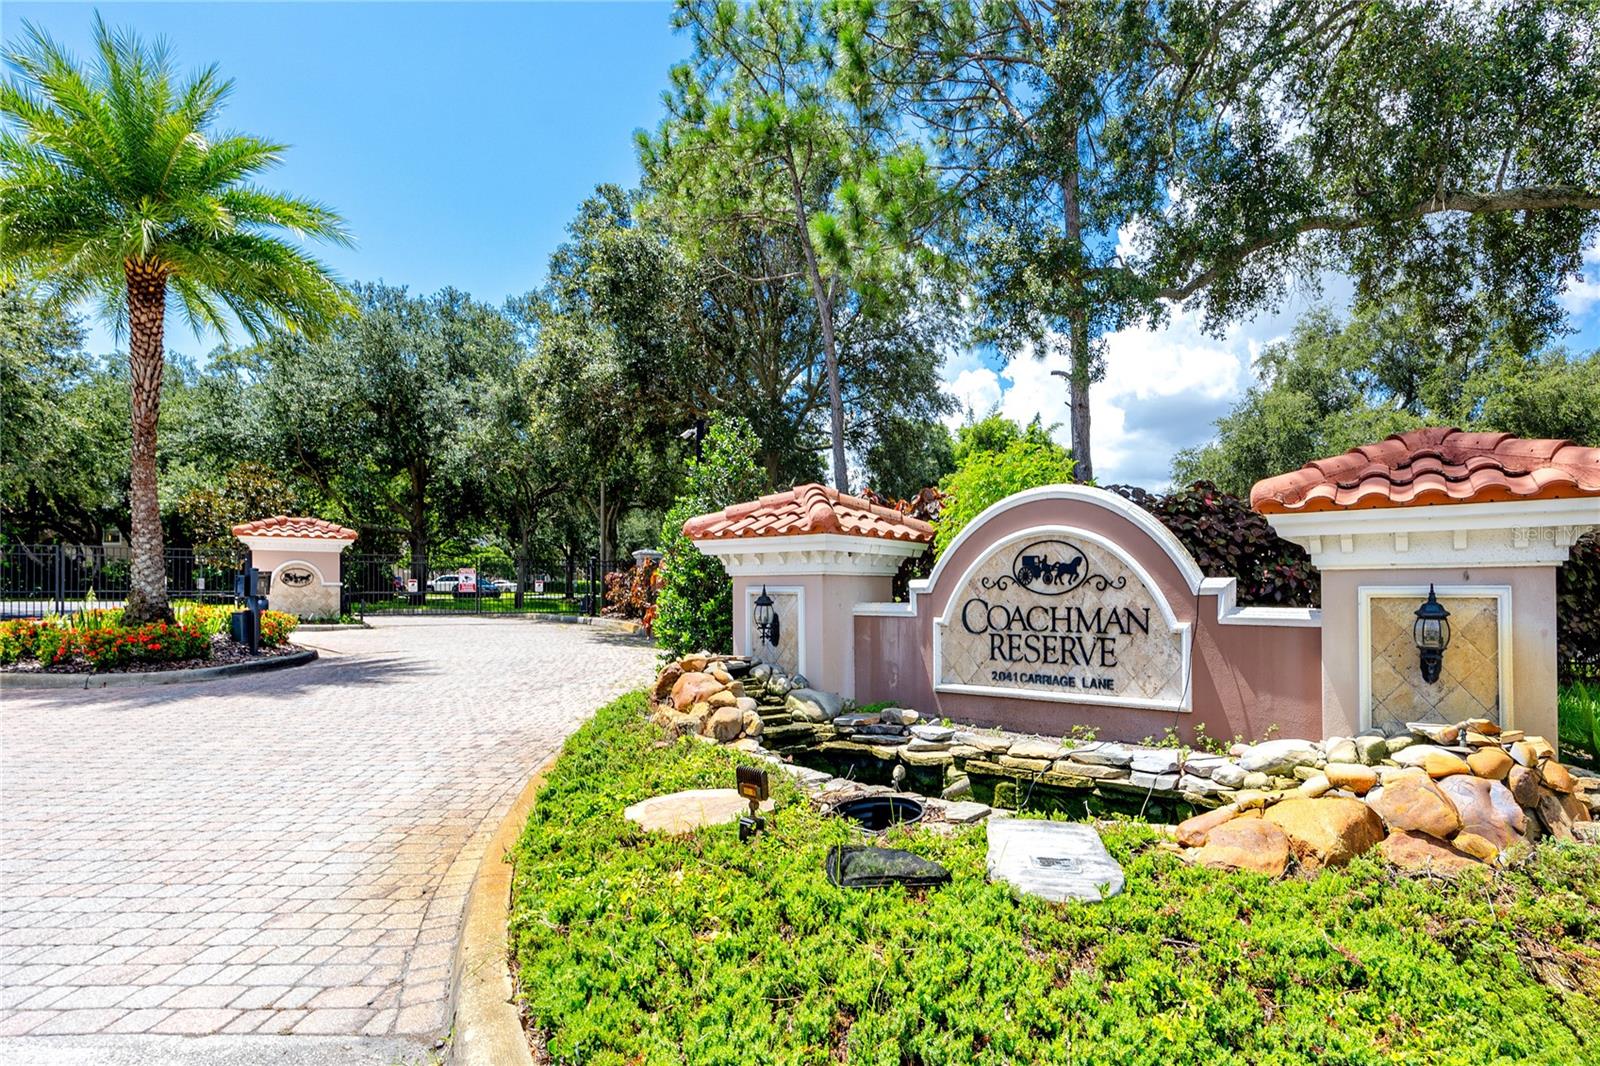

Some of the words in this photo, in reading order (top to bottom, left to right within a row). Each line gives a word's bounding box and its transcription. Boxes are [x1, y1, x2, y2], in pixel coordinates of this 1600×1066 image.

[961, 598, 1150, 635] COACHMAN
[989, 633, 1118, 668] RESERVE
[991, 671, 1018, 683] 2041
[1020, 672, 1076, 688] CARRIAGE
[1082, 677, 1115, 691] LANE
